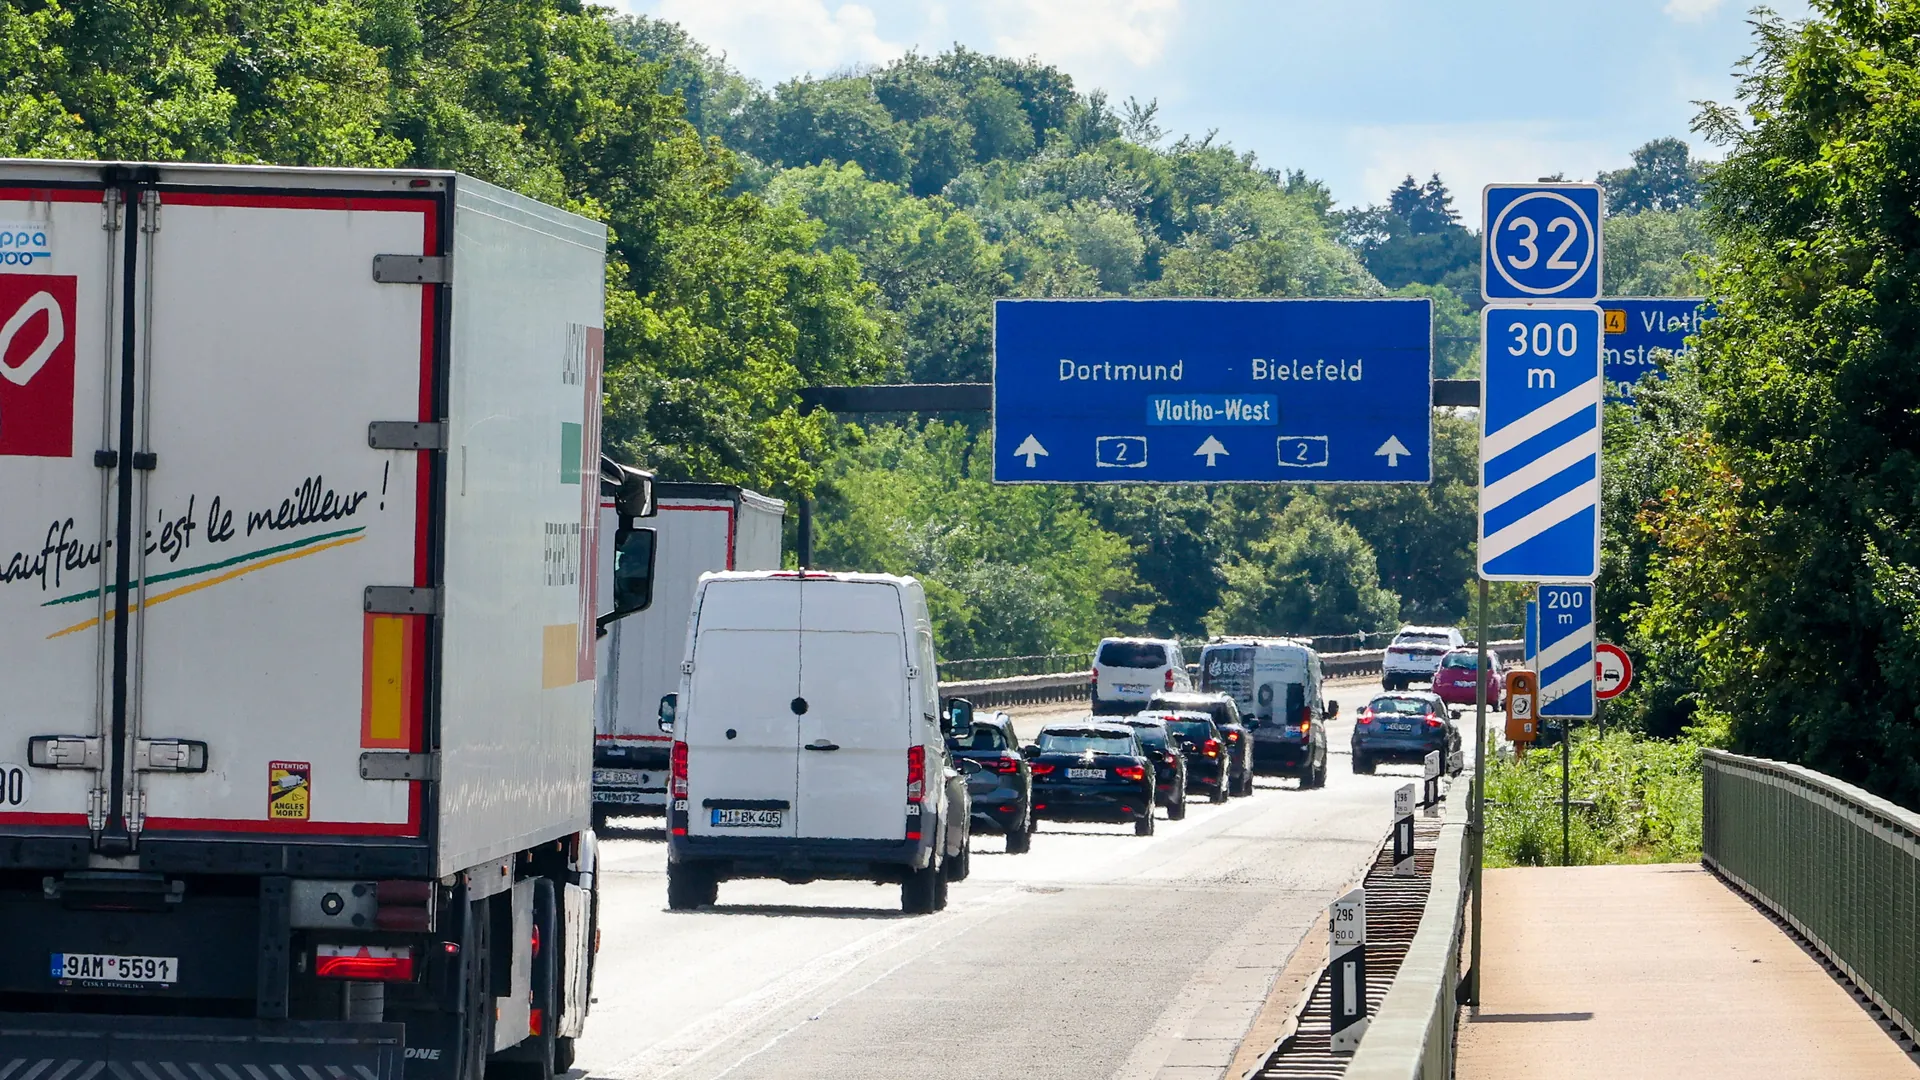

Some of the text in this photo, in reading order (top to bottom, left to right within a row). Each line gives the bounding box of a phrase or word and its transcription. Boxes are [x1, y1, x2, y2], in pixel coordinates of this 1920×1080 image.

[1507, 216, 1578, 270] 32
[1641, 310, 1719, 333] Vloth
[1508, 322, 1577, 357] 300
[1059, 358, 1362, 381] Dortmund Bielefeld
[1527, 368, 1555, 388] m
[1155, 398, 1270, 421] Vlotho-West
[1116, 442, 1128, 461] 2
[1296, 442, 1308, 461] 2
[207, 495, 235, 543] le
[247, 474, 367, 537] meilleur
[380, 460, 389, 511] !
[1547, 591, 1583, 609] 200
[1558, 613, 1573, 624] m
[720, 811, 780, 823] HI BK 405
[1336, 908, 1354, 922] 296
[67, 956, 170, 980] 9AM 5591
